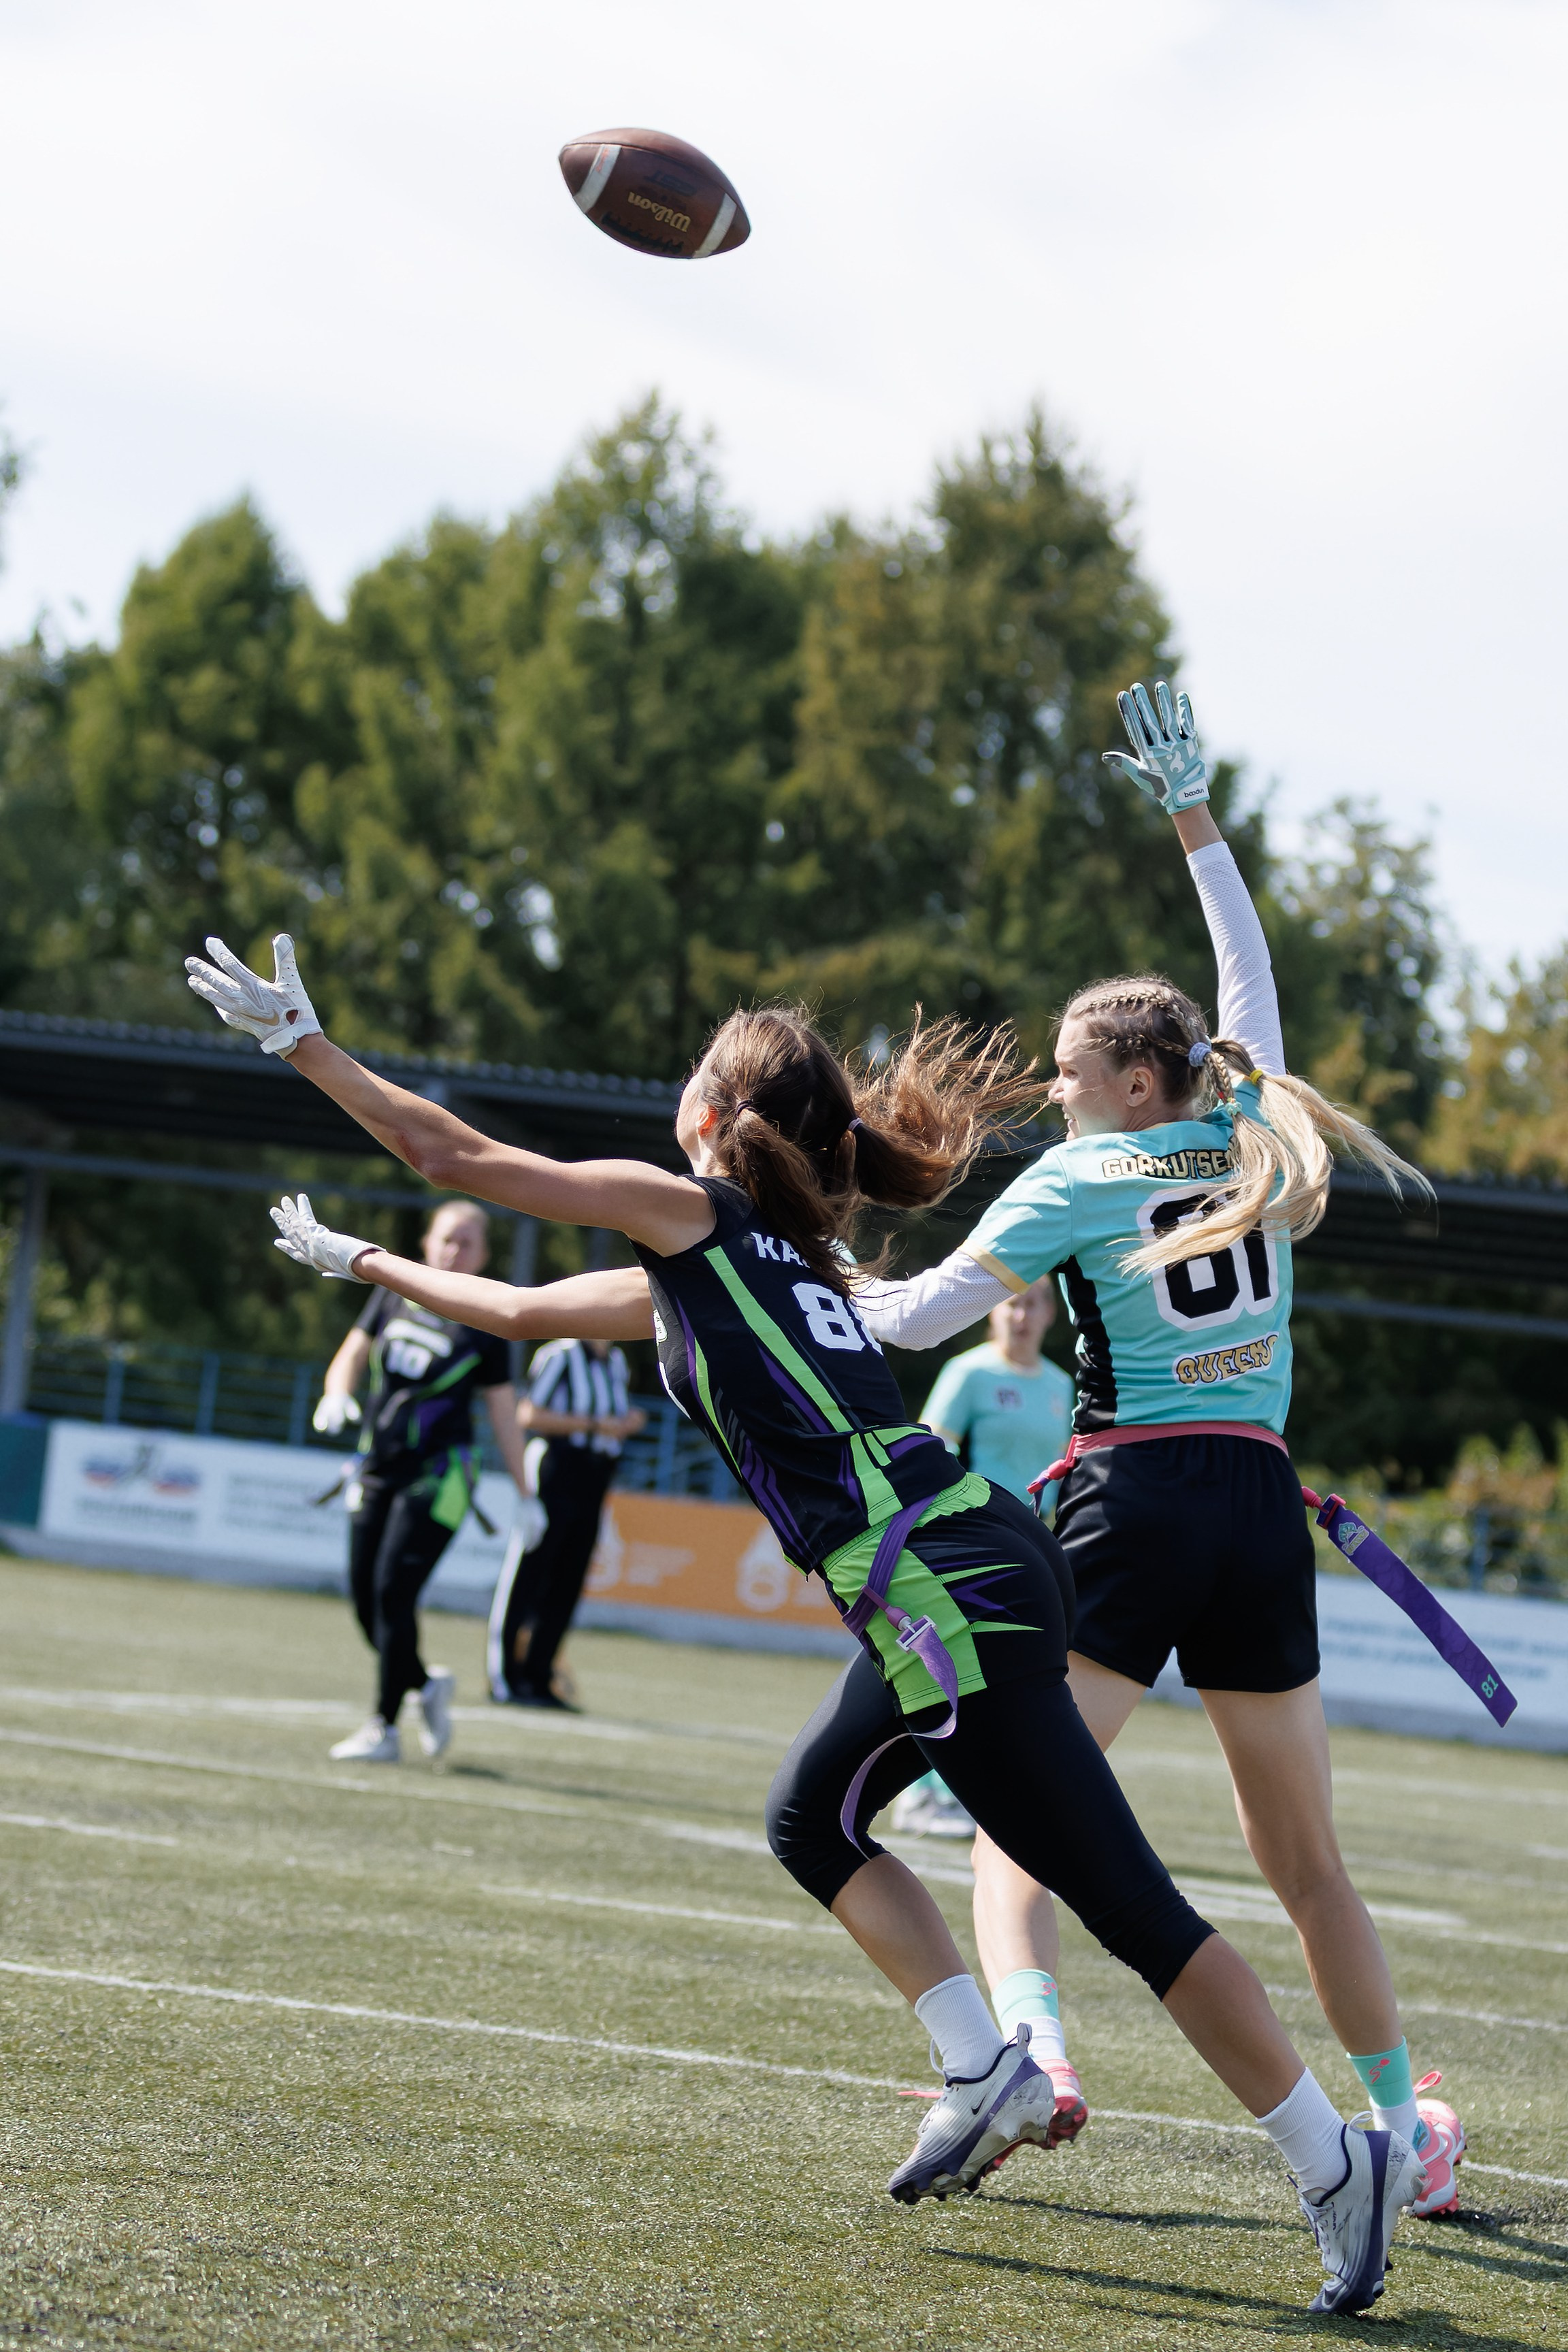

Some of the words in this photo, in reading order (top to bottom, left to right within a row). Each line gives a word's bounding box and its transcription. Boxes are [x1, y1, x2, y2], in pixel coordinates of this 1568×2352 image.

[627, 191, 691, 232] Wilson
[751, 1232, 810, 1268] KA
[1481, 1673, 1499, 1699] 81
